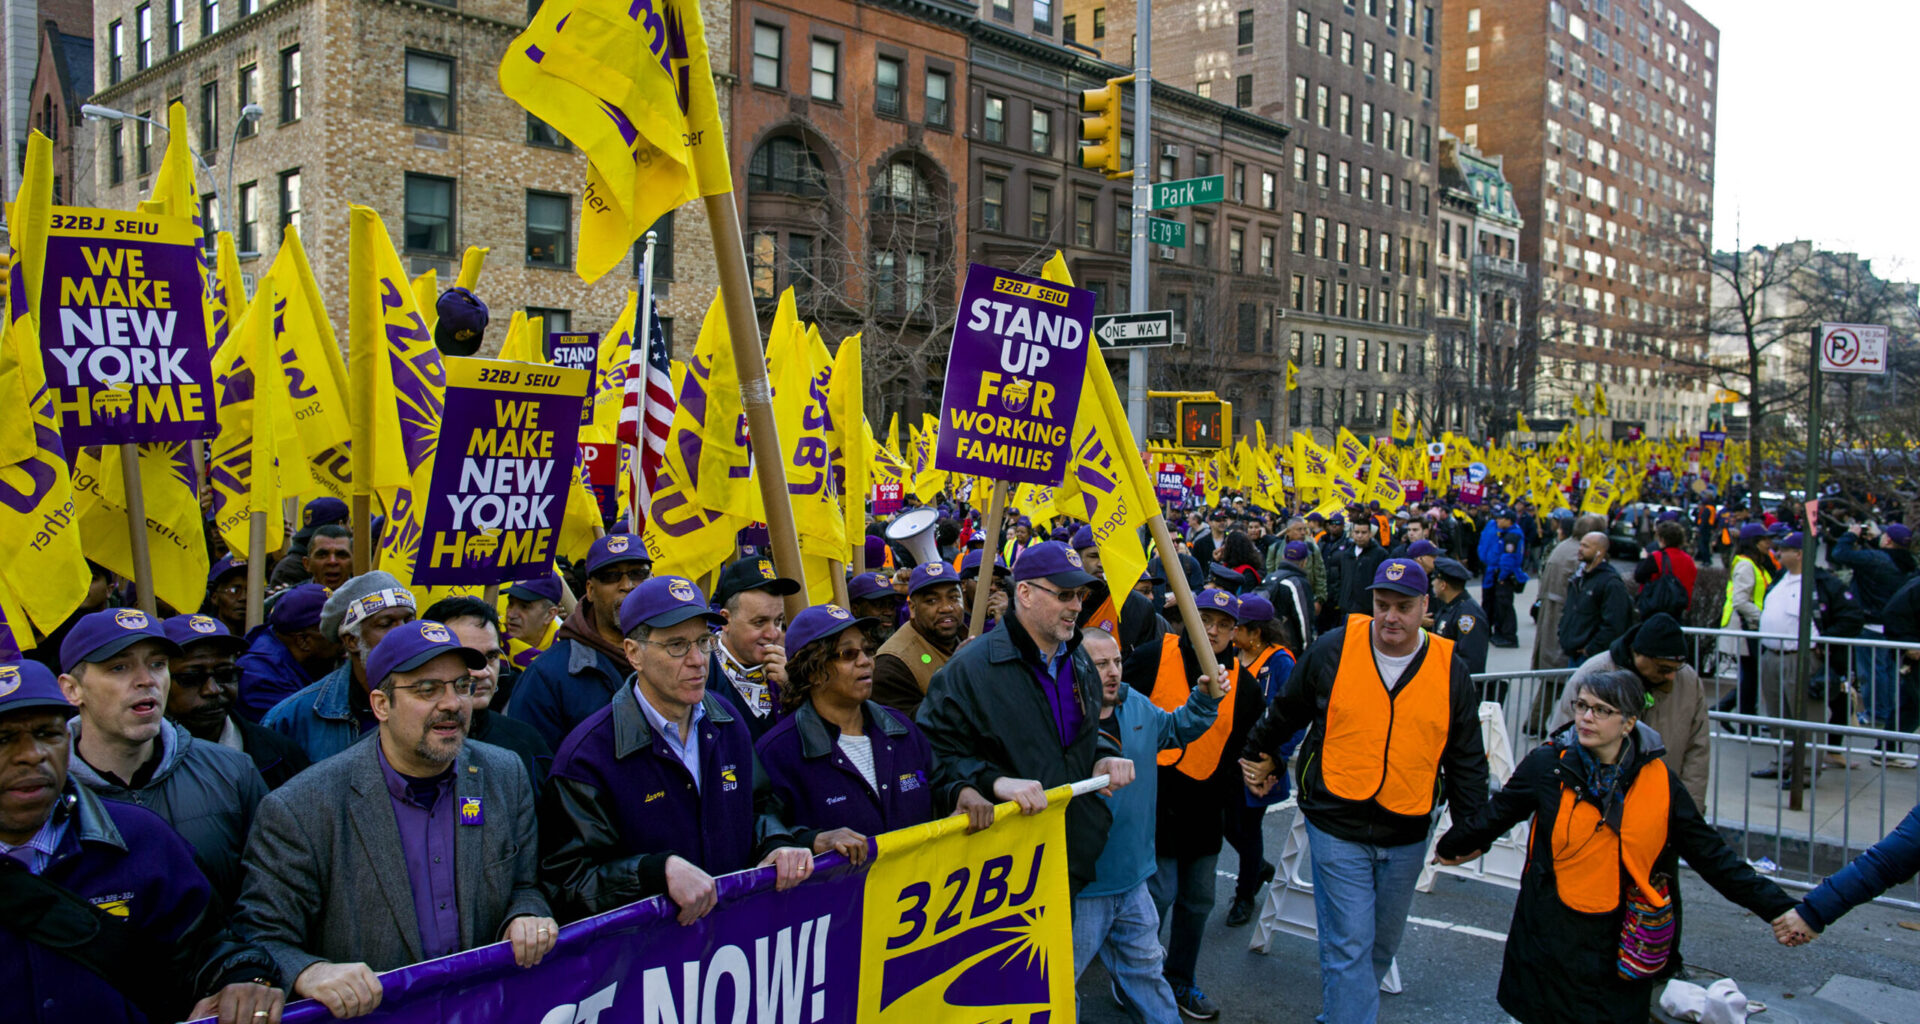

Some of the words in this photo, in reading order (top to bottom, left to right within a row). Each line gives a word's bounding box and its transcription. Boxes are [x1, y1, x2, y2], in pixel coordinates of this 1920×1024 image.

[1161, 183, 1194, 206] Park
[1201, 180, 1213, 192] Av
[50, 214, 105, 231] 32BJ
[114, 219, 159, 235] SEIU
[1152, 222, 1157, 240] E
[1161, 224, 1171, 242] 79
[1175, 225, 1181, 235] St
[80, 246, 145, 278] WE
[60, 276, 171, 309] MAKE
[996, 279, 1031, 296] 32BJ
[1037, 288, 1067, 304] SEIU
[59, 308, 178, 346] NEW
[967, 298, 1083, 350] STAND
[1105, 325, 1126, 338] ONE
[1137, 322, 1161, 336] WAY
[48, 346, 195, 386] YORK
[553, 346, 596, 363] STAND
[1000, 340, 1050, 377] UP
[478, 368, 519, 385] 32BJ
[525, 373, 561, 388] SEIU
[495, 399, 540, 429] WE
[951, 408, 1066, 447] WORKING
[466, 428, 555, 458] MAKE
[956, 437, 1053, 472] FAMILIES
[459, 458, 555, 494] NEW
[880, 484, 899, 492] GOOD
[1160, 473, 1182, 484] FAIR
[1373, 484, 1400, 500] SEIU
[446, 494, 555, 530] YORK
[886, 843, 1045, 950] 32BJ
